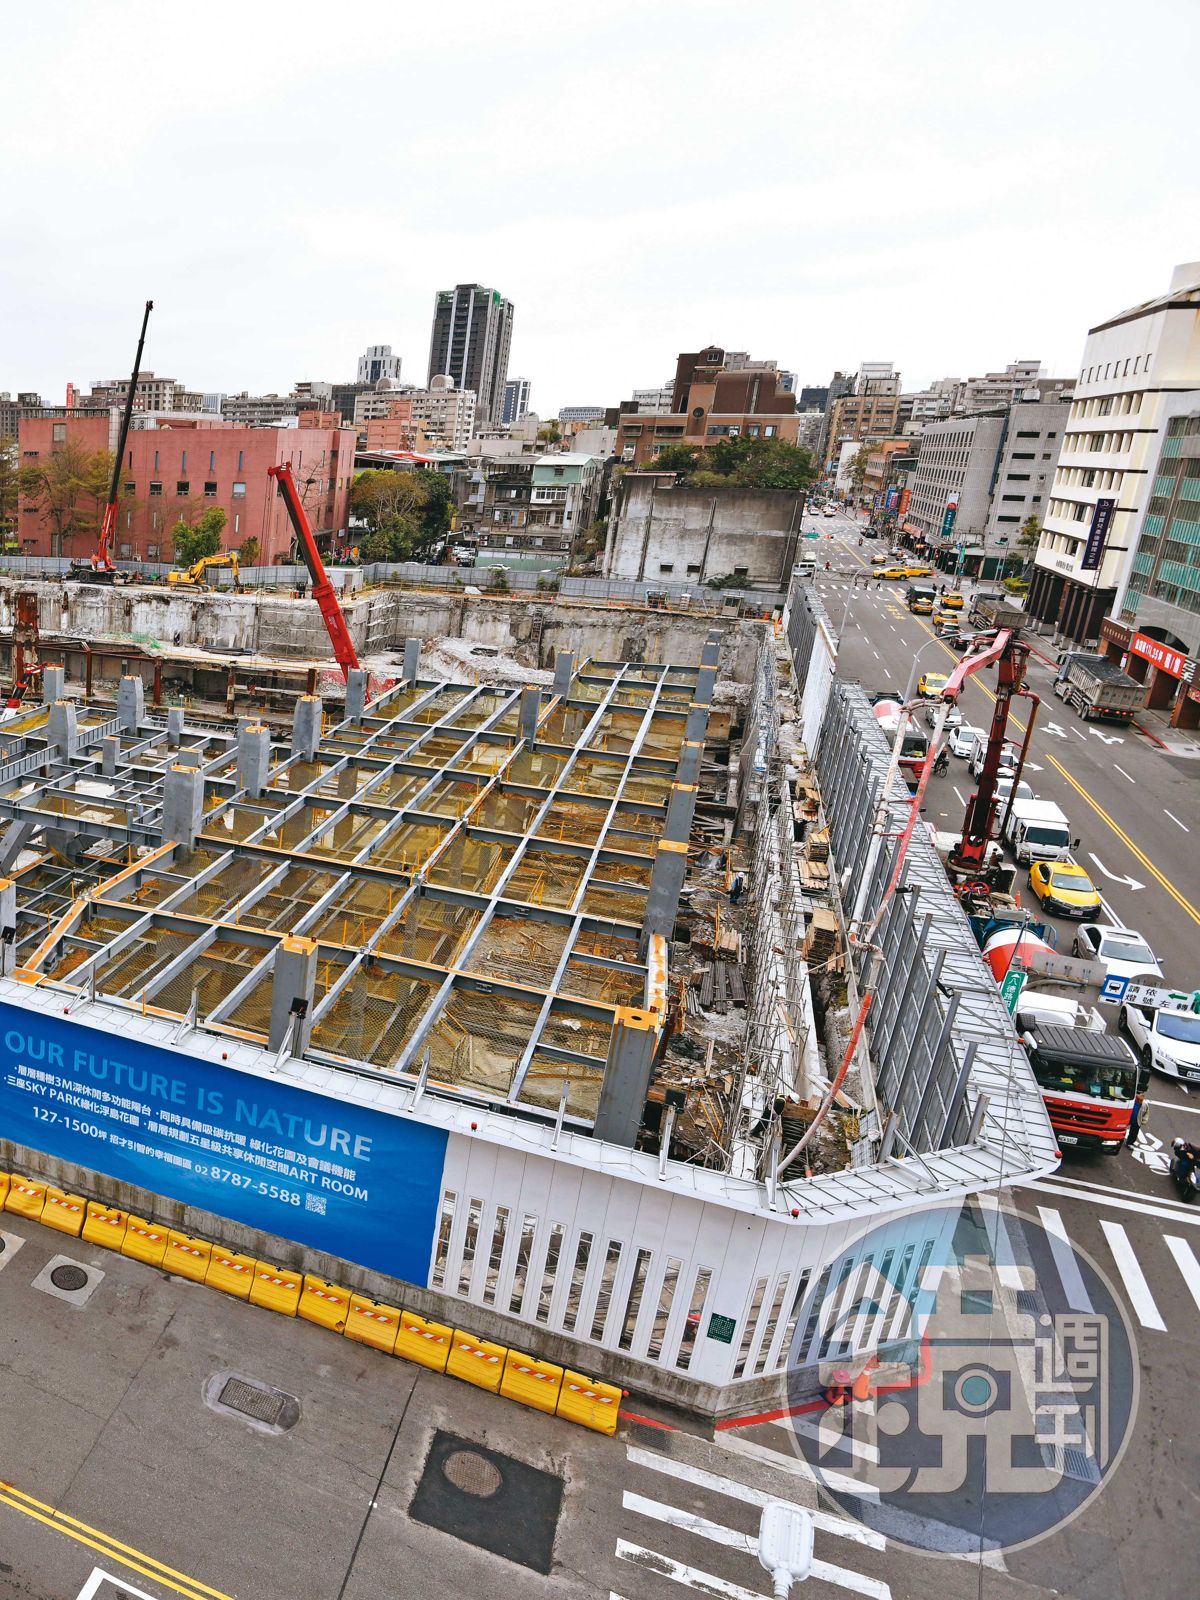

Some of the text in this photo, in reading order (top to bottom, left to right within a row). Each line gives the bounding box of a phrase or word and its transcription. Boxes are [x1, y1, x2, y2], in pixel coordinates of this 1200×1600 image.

[5, 1030, 373, 1162] OUR FUTURE IS NATURE
[32, 1106, 108, 1141] 127-1500坪
[194, 1164, 209, 1176] 02
[210, 1166, 301, 1206] 8787-5588
[321, 1176, 369, 1202] ROOM
